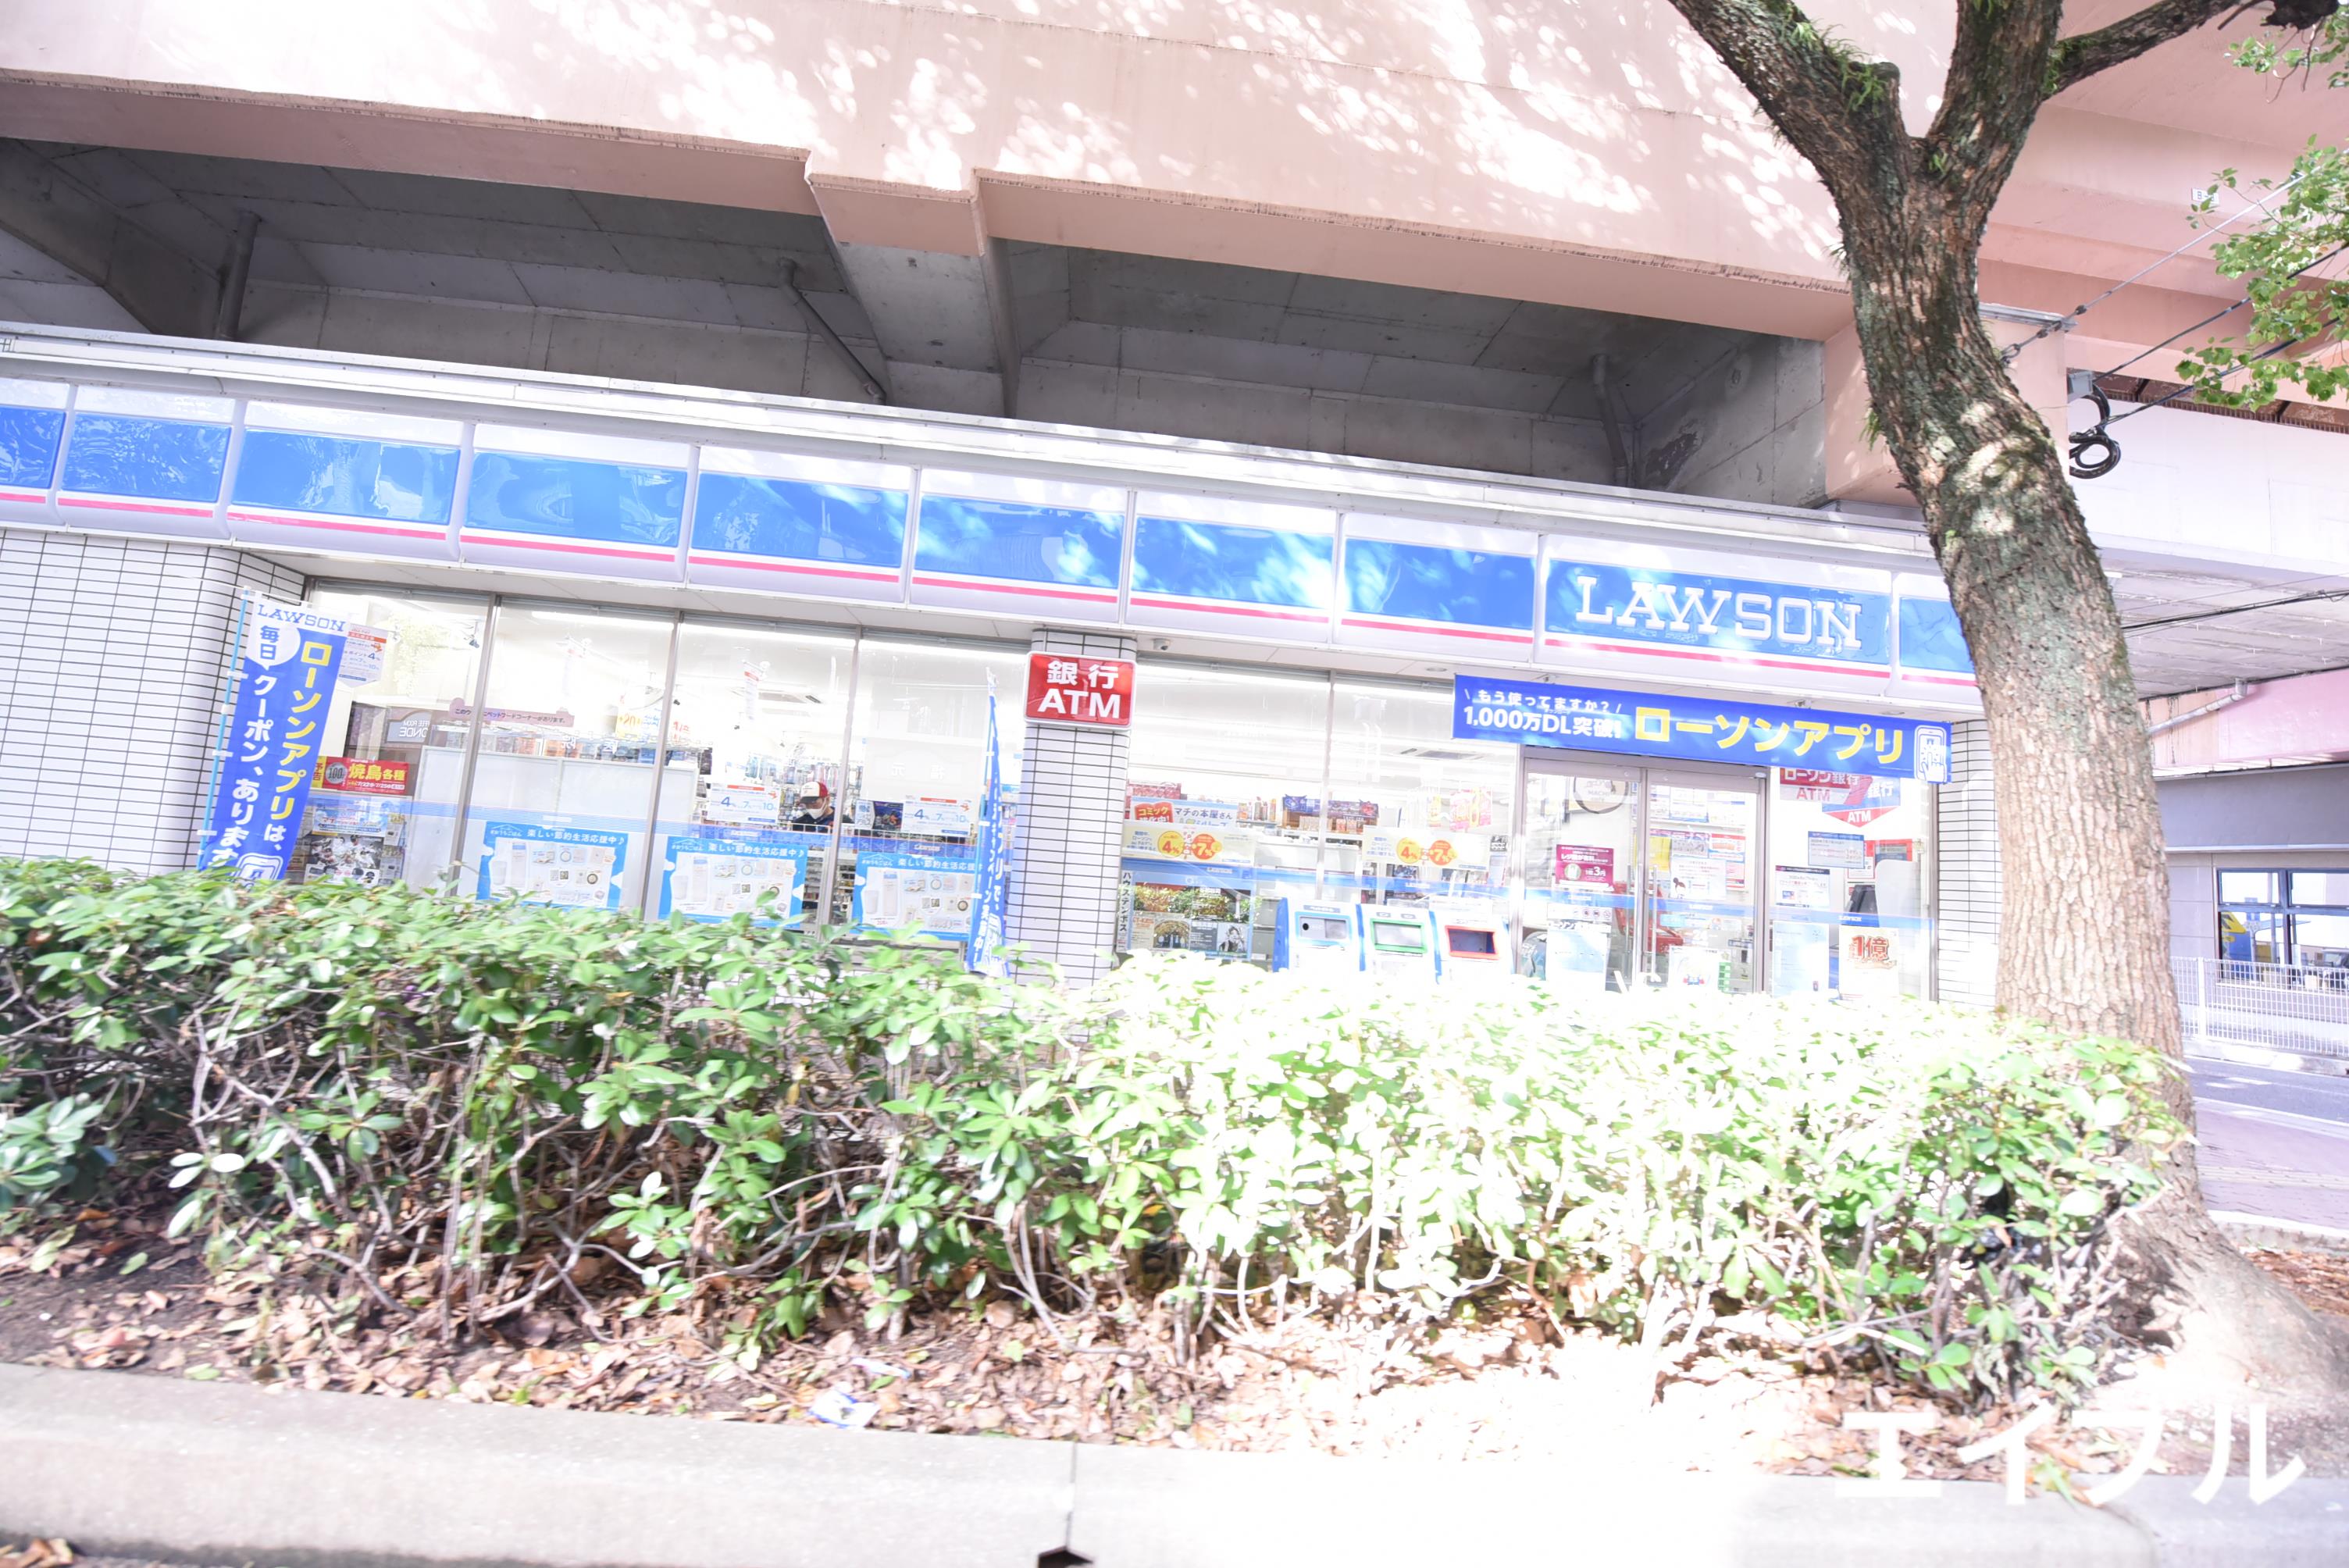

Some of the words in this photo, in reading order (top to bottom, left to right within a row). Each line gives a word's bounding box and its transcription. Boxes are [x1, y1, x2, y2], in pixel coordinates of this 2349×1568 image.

[258, 604, 346, 633] LAWSON
[1575, 576, 1863, 650] LAWSON
[260, 625, 280, 661] 毎日
[1047, 660, 1119, 690] 銀行
[1037, 688, 1121, 719] ATM
[1463, 706, 1623, 739] 1,000万DL突破!
[1635, 706, 1903, 765] ローソンアプリ
[263, 641, 333, 851] ローソンアプリは、
[348, 762, 406, 781] 焼鳥各種
[1796, 787, 1830, 802] ATM
[1138, 807, 1169, 816] コミック
[1174, 807, 1233, 820] マチの本屋さん
[1848, 810, 1871, 823] ATM
[1851, 935, 1890, 961] 1億
